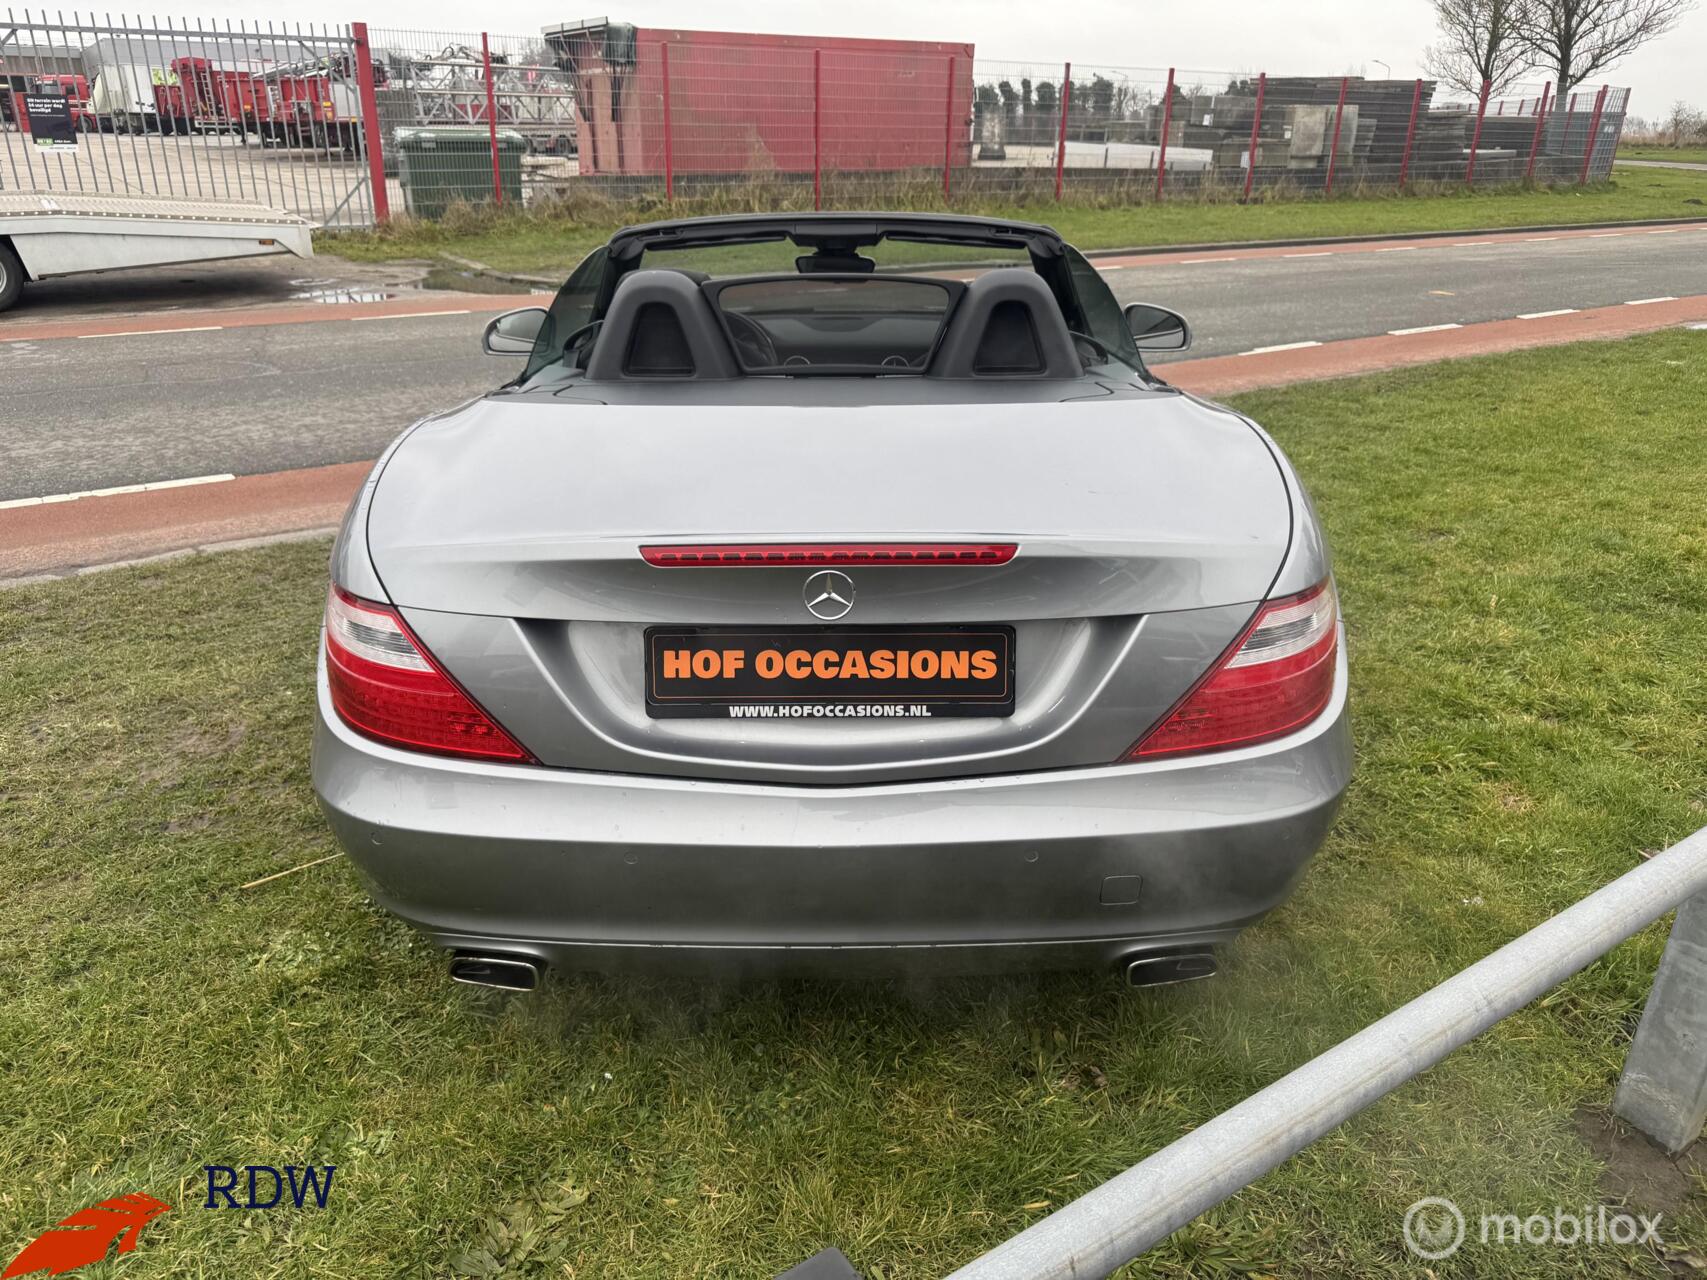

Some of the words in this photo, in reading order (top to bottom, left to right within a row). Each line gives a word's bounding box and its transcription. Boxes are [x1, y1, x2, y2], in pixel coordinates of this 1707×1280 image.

[663, 650, 745, 679] HOF
[755, 649, 997, 680] OCCASIONS
[729, 704, 932, 718] WWW.HOFOCCASIONS.NL
